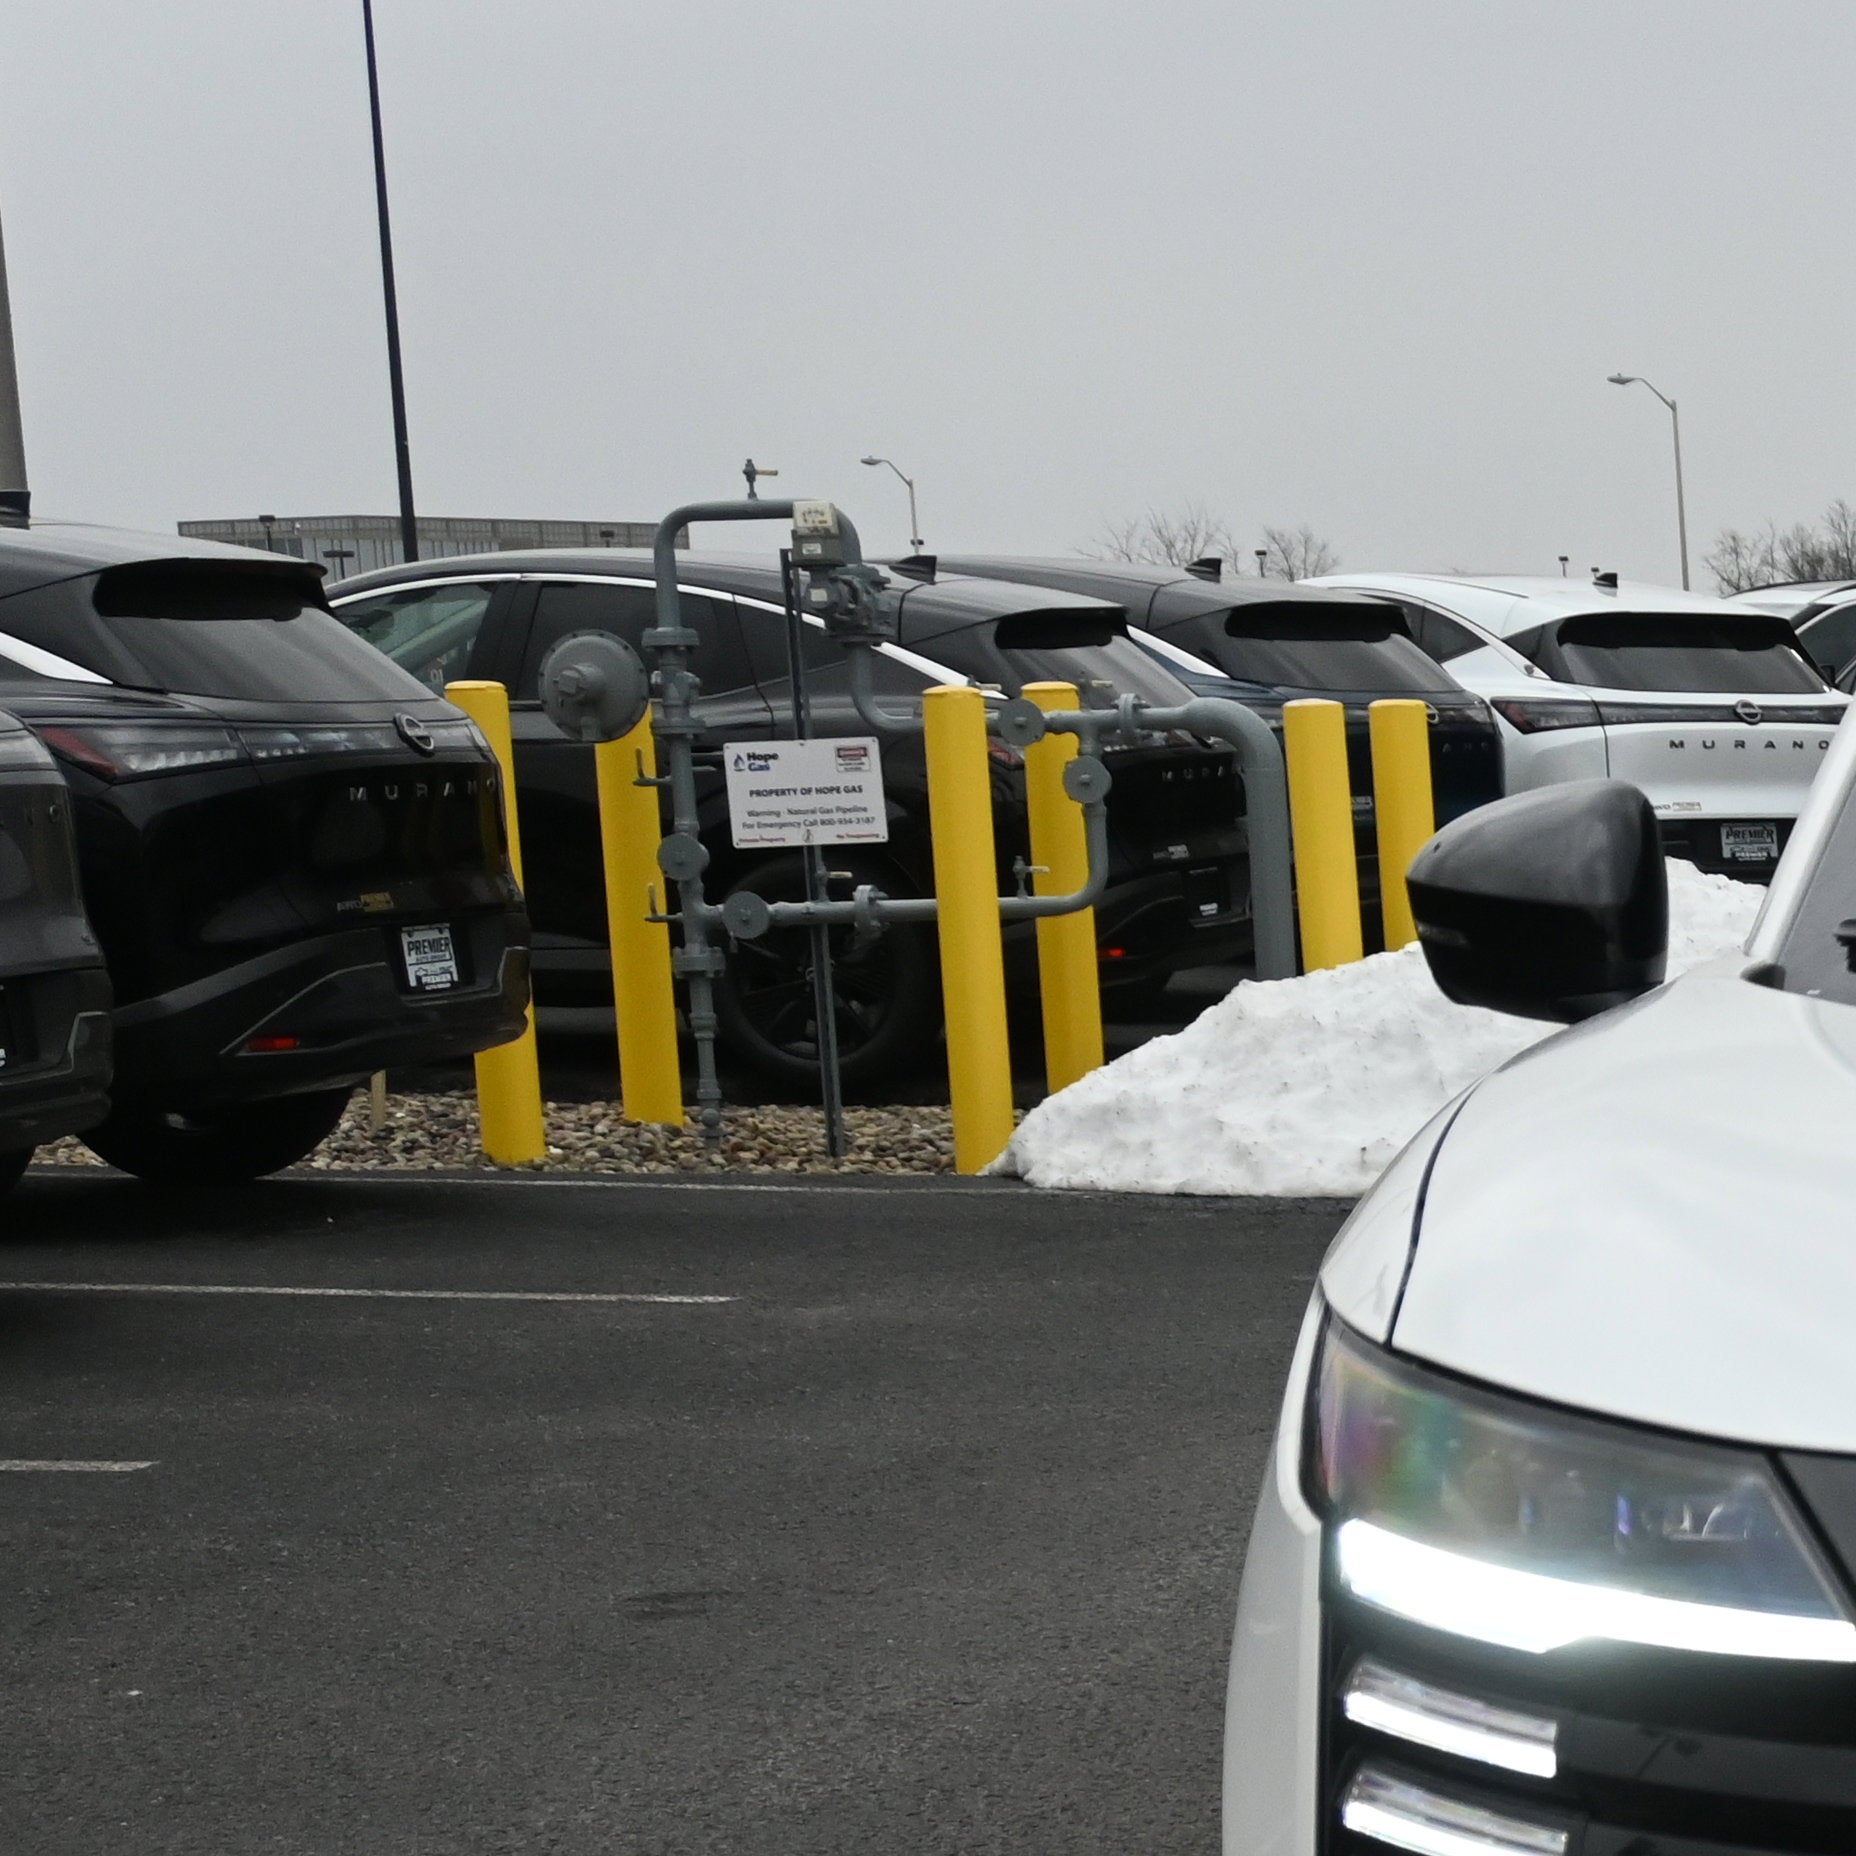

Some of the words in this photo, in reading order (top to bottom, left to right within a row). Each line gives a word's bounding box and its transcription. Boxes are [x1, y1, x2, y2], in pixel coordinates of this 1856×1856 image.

[1669, 739, 1829, 750] MURANO
[747, 752, 779, 762] Hope
[748, 762, 770, 772] Gas
[749, 788, 797, 798] PROPERTY
[800, 787, 813, 796] OF
[815, 786, 841, 796] HOPE
[843, 785, 863, 794] GAS
[747, 809, 781, 818] Warning
[787, 807, 817, 816] Natural
[818, 806, 833, 815] Gas
[836, 805, 868, 815] Pipeline
[742, 821, 755, 830] For
[757, 820, 801, 831] Emergency
[803, 818, 819, 827] Call
[407, 936, 450, 957] PREMIER
